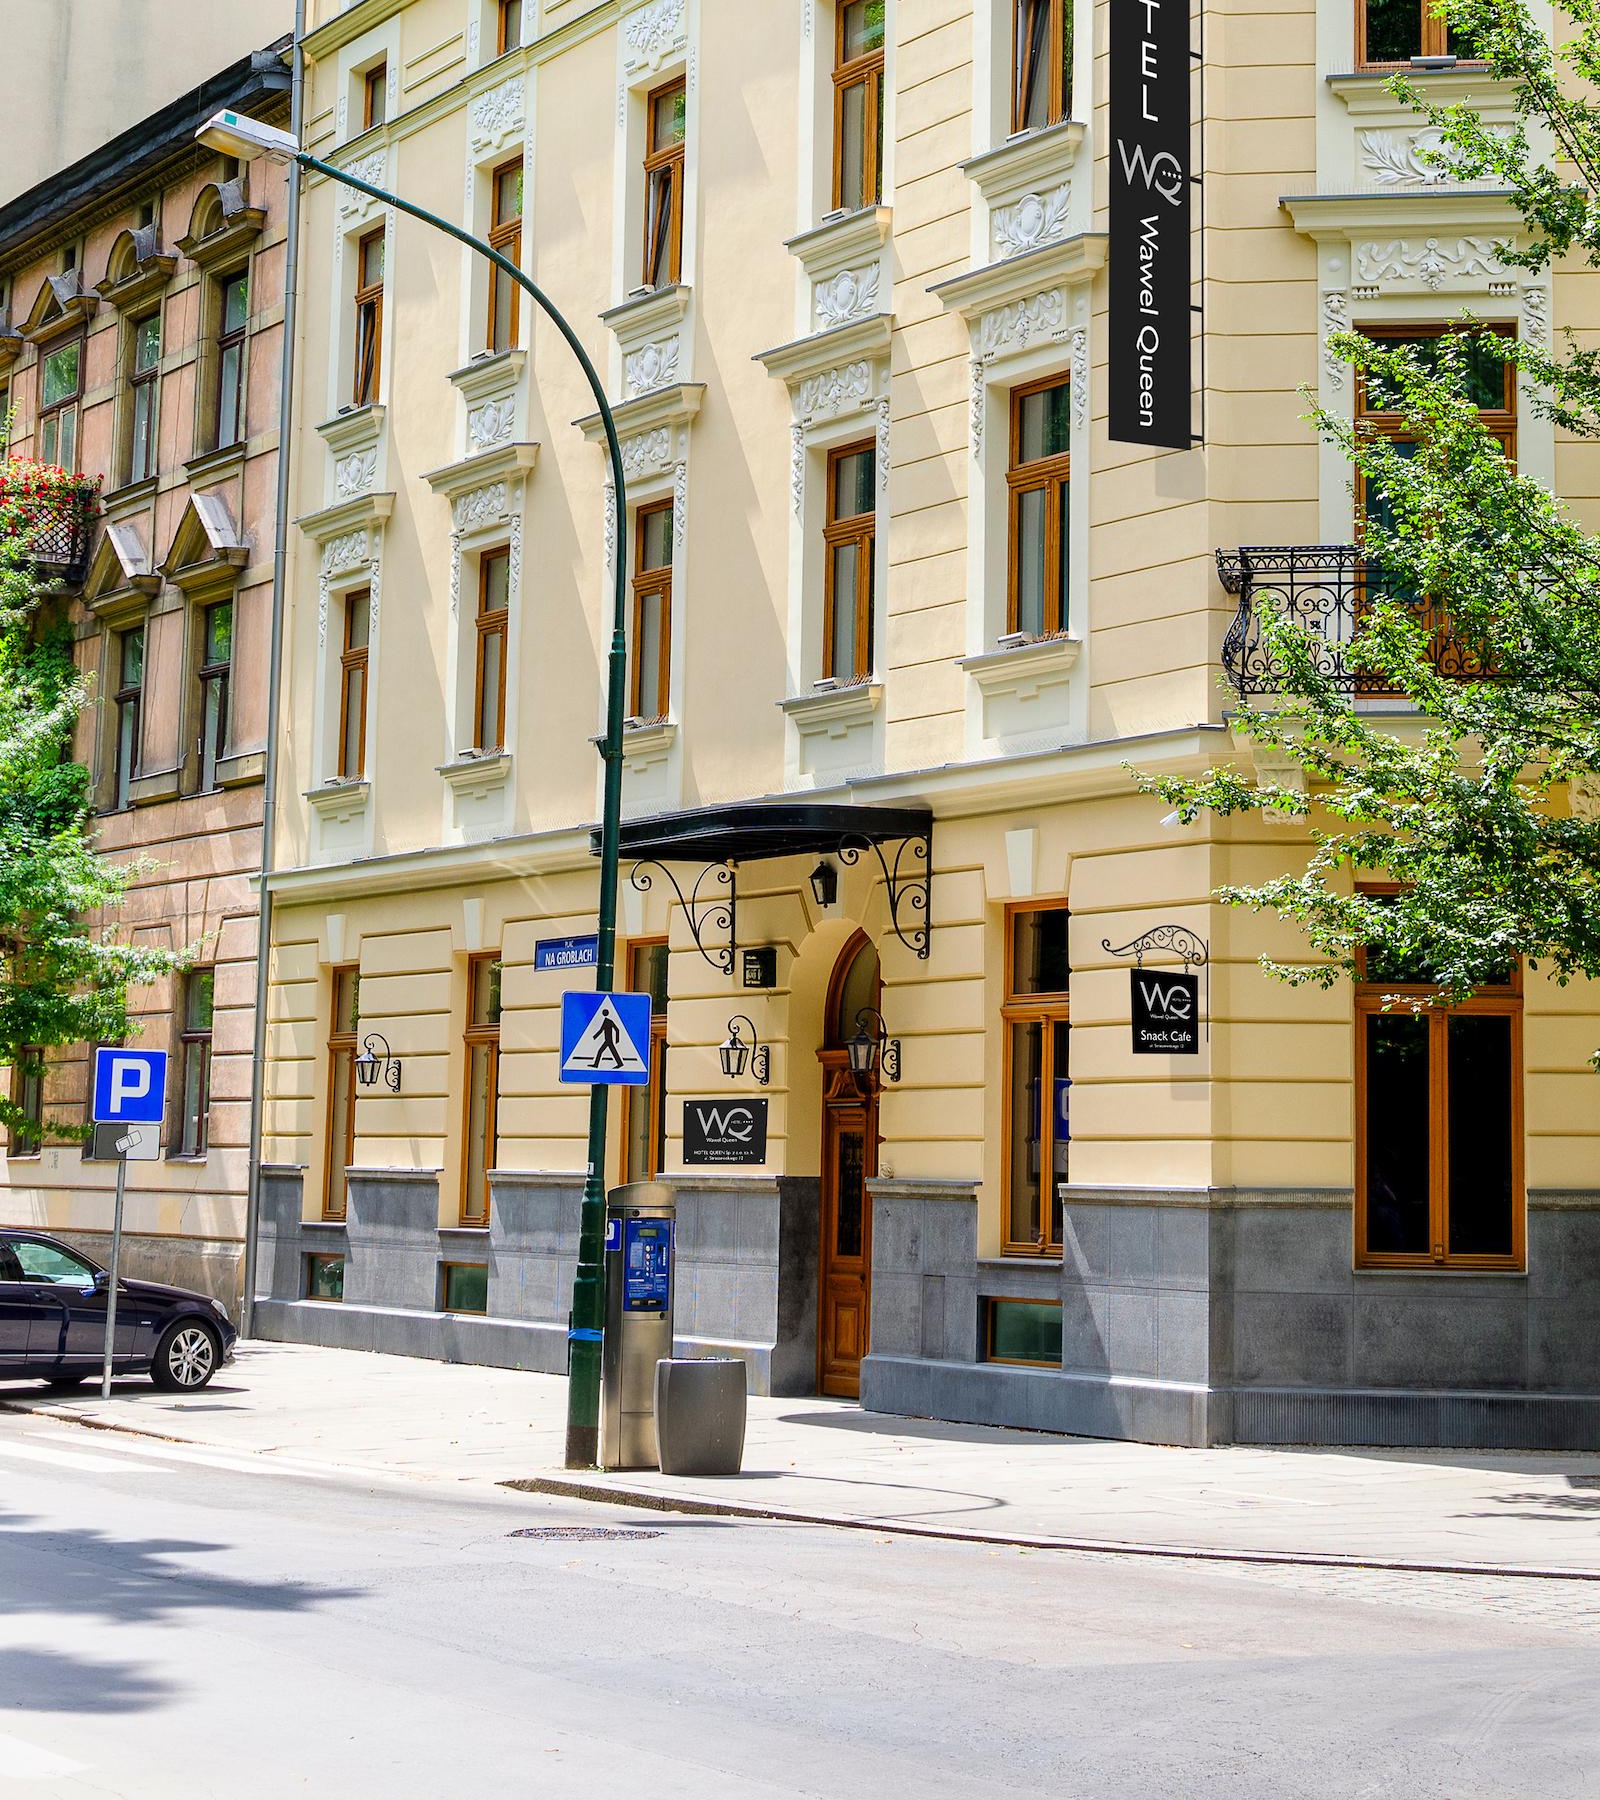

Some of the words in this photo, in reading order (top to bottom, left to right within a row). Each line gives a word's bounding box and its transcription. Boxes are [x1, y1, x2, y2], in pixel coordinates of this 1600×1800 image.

[1139, 214, 1160, 316] Wawel
[1136, 325, 1160, 428] Queen
[545, 952, 556, 966] NA
[556, 949, 593, 965] GROBLACH
[1140, 1029, 1168, 1041] Snack
[1170, 1030, 1192, 1042] Cafe
[110, 1058, 151, 1113] P
